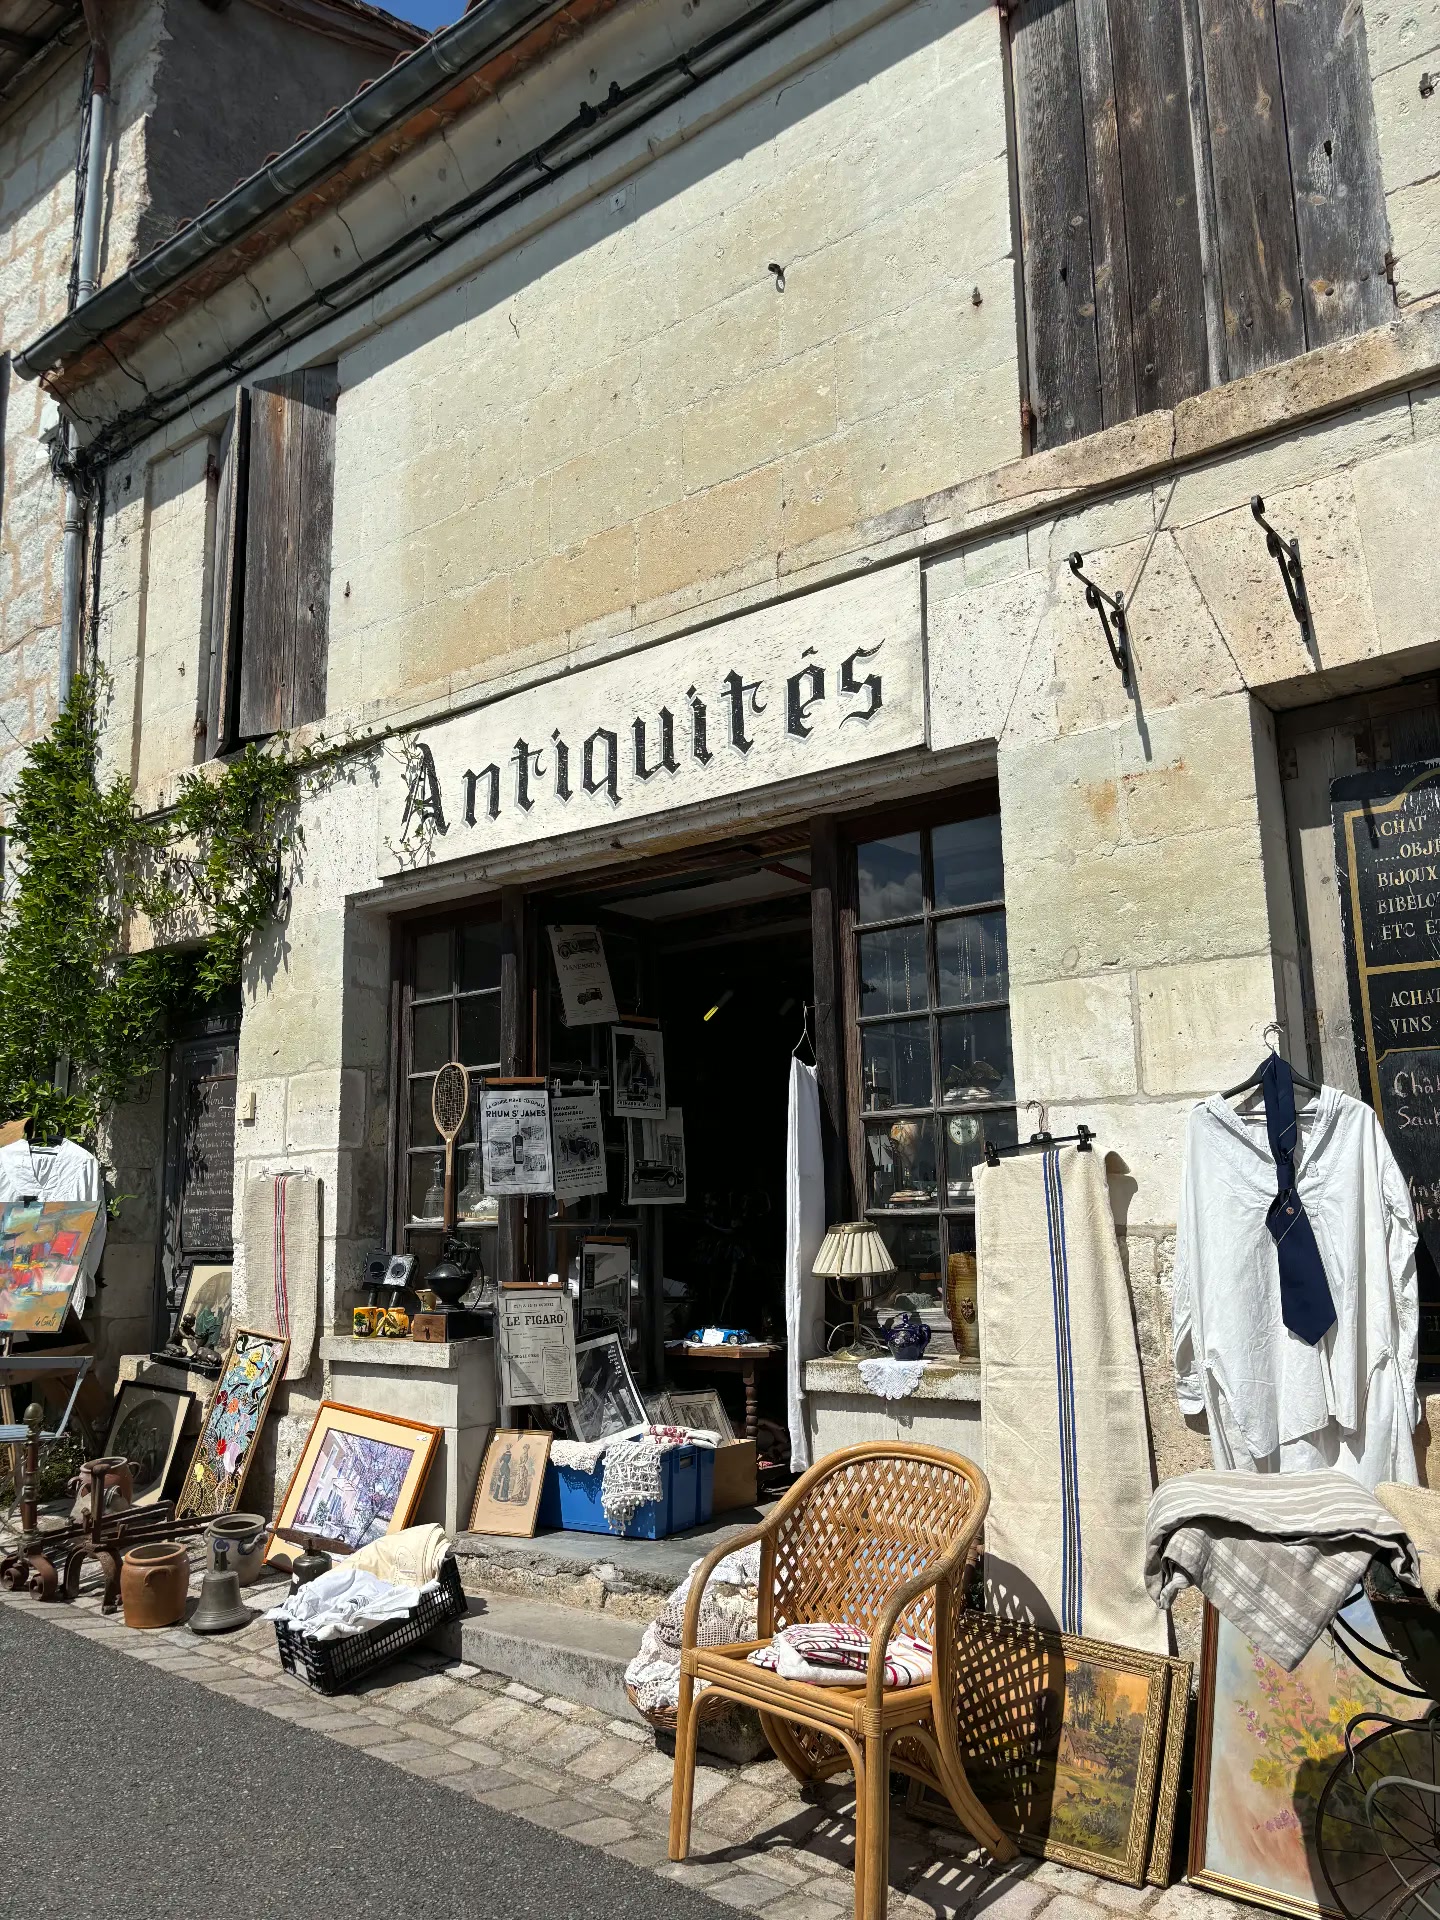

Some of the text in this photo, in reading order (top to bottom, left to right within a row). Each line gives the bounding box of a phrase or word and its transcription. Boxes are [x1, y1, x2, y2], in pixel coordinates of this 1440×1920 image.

[1370, 815, 1427, 839] ACHAT
[1377, 865, 1439, 888] BIJOUX
[1382, 922, 1416, 941] ETC
[1389, 1015, 1433, 1037] VINS
[485, 1110, 510, 1118] RHUM
[520, 1109, 547, 1117] JAMES
[505, 1313, 564, 1327] LE FIGARO
